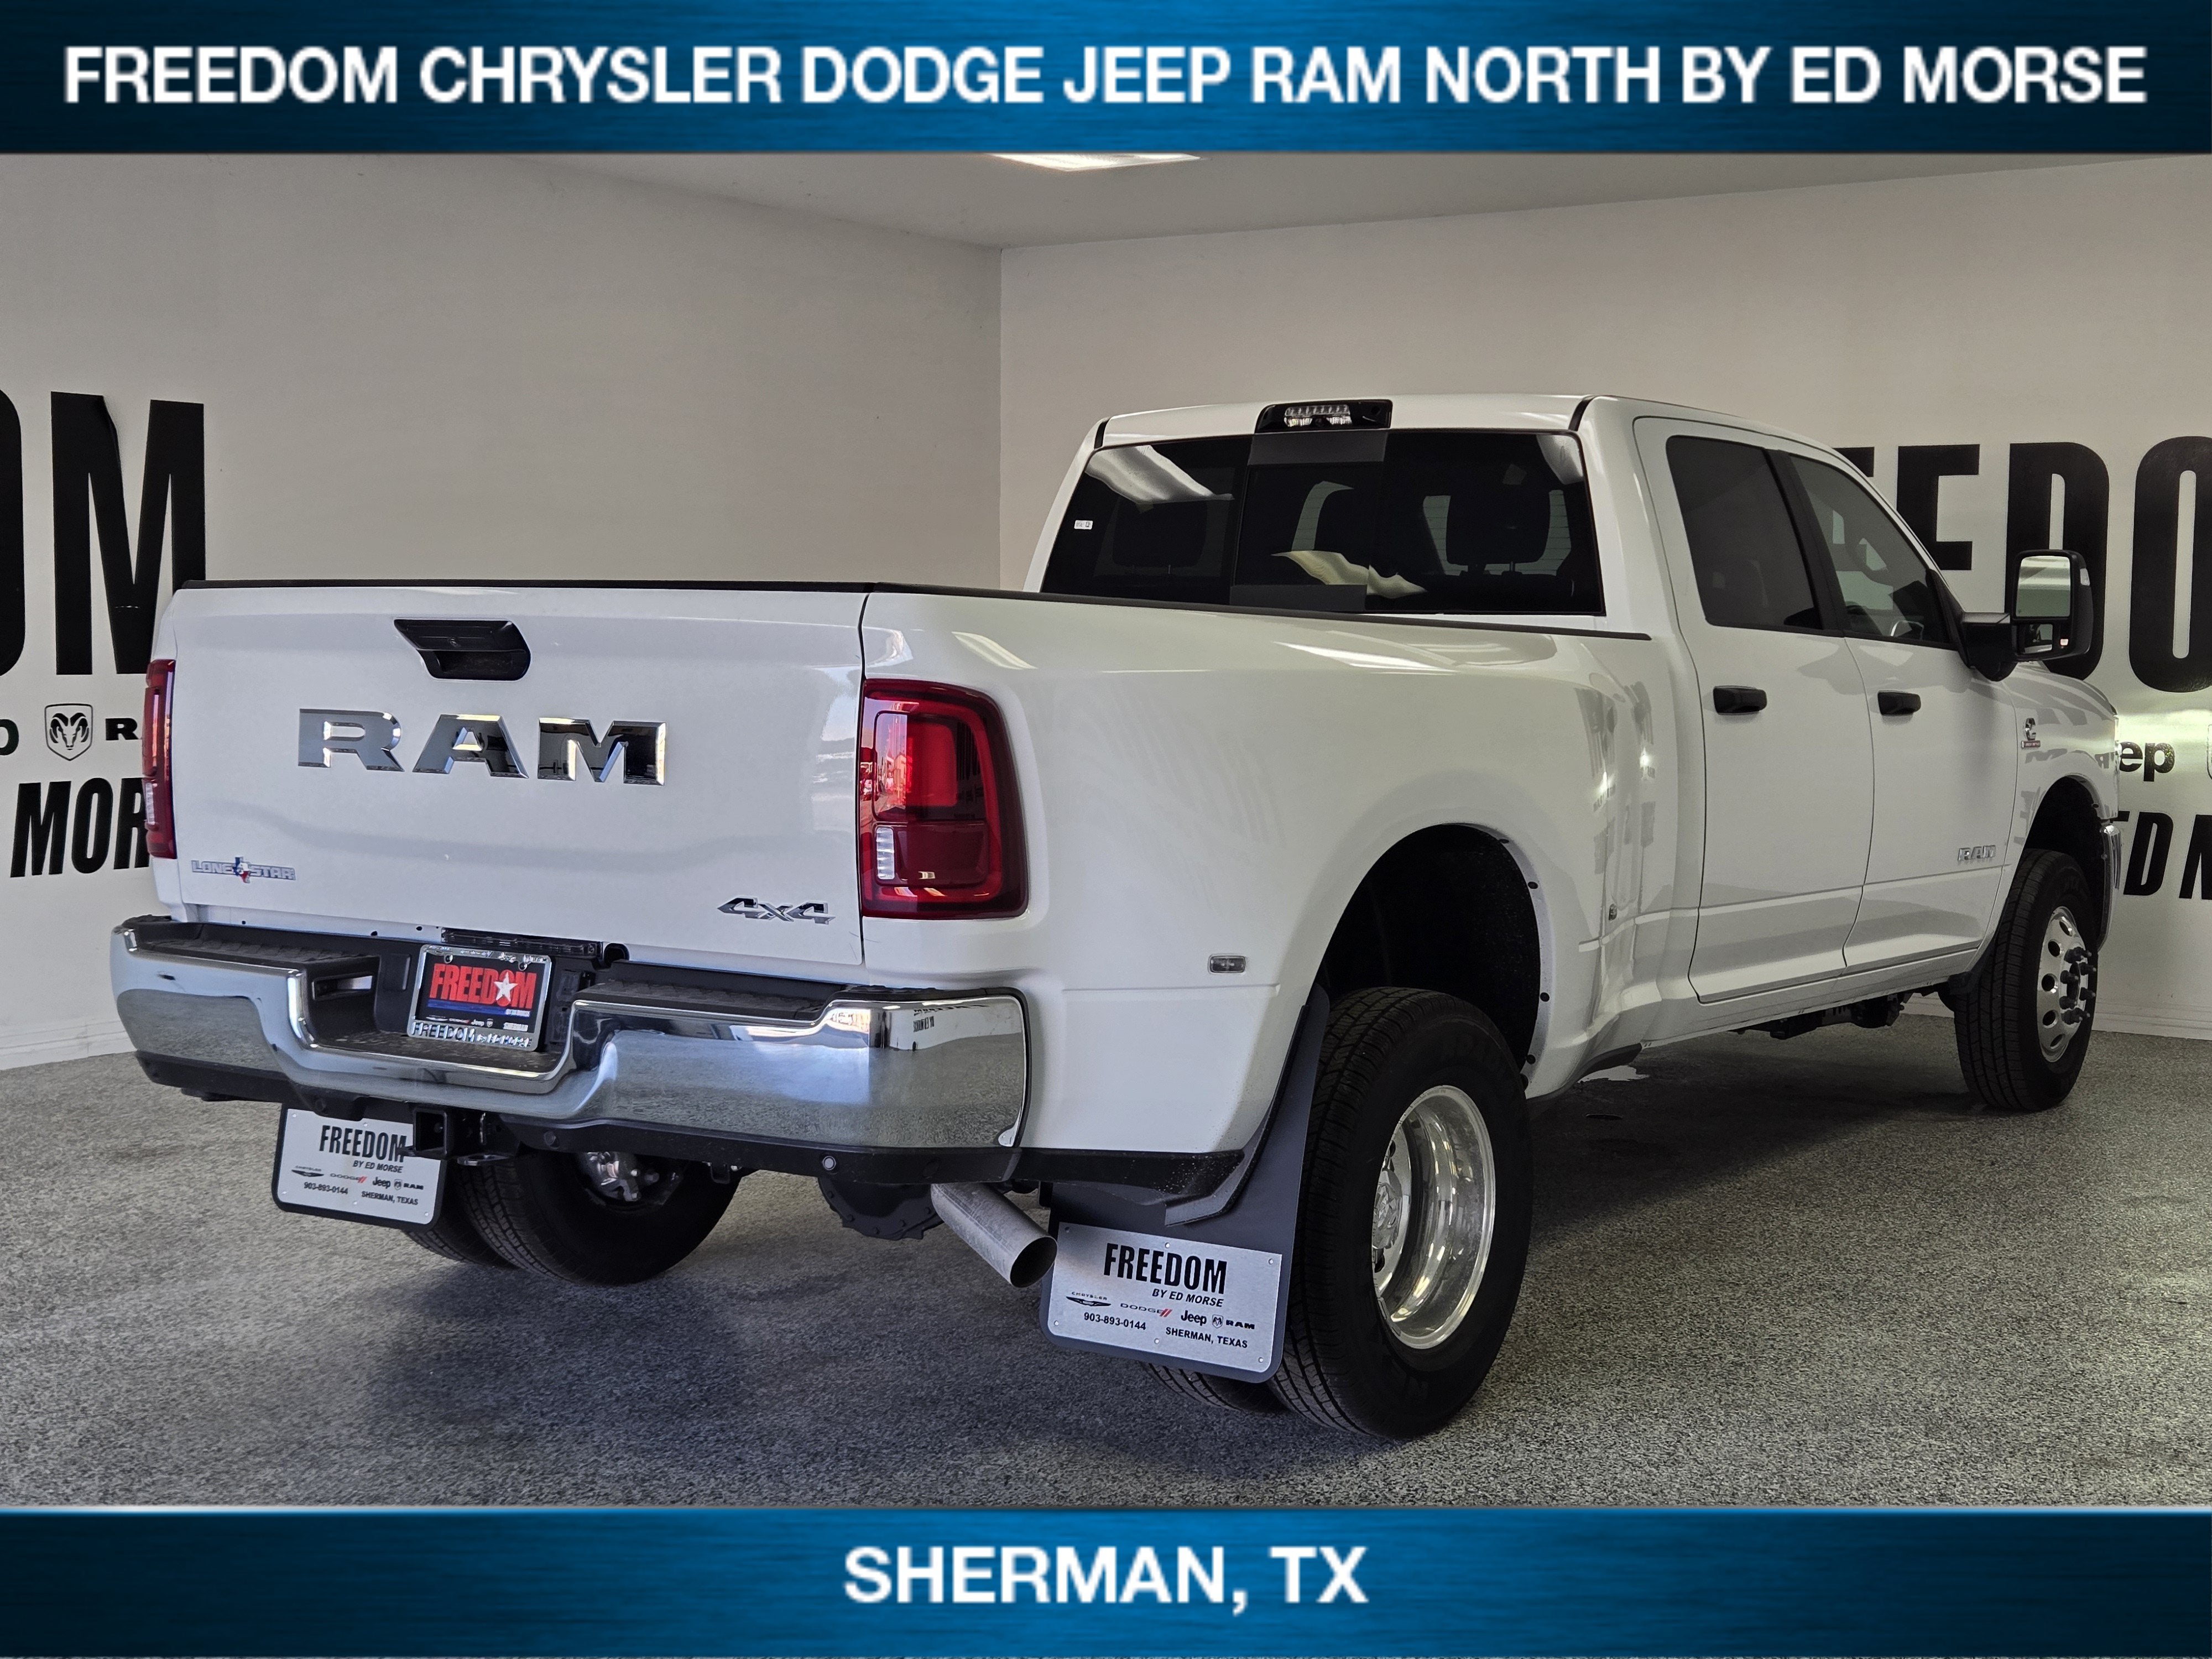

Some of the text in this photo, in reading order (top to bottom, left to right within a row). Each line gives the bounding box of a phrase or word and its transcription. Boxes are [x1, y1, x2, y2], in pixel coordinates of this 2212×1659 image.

[298, 708, 666, 786] RAM
[1958, 844, 1996, 861] RAM
[191, 860, 295, 880] LONE STAR
[412, 1021, 476, 1042] FREEDOM
[319, 1125, 406, 1162] FREEDOM
[377, 1163, 404, 1173] MORSE
[373, 1176, 391, 1189] Jeep
[361, 1191, 419, 1205] SHERMAN, TEXAS
[1103, 1243, 1227, 1295] FREEDOM
[1072, 1291, 1107, 1301] CHRYSLER
[1152, 1288, 1224, 1307] BY ED MORSE
[1084, 1312, 1146, 1331] 903-893-0144
[1181, 1310, 1207, 1326] Jeep
[1225, 1319, 1255, 1330] RAM
[1165, 1327, 1248, 1348] SHERMAN, TEXAS
